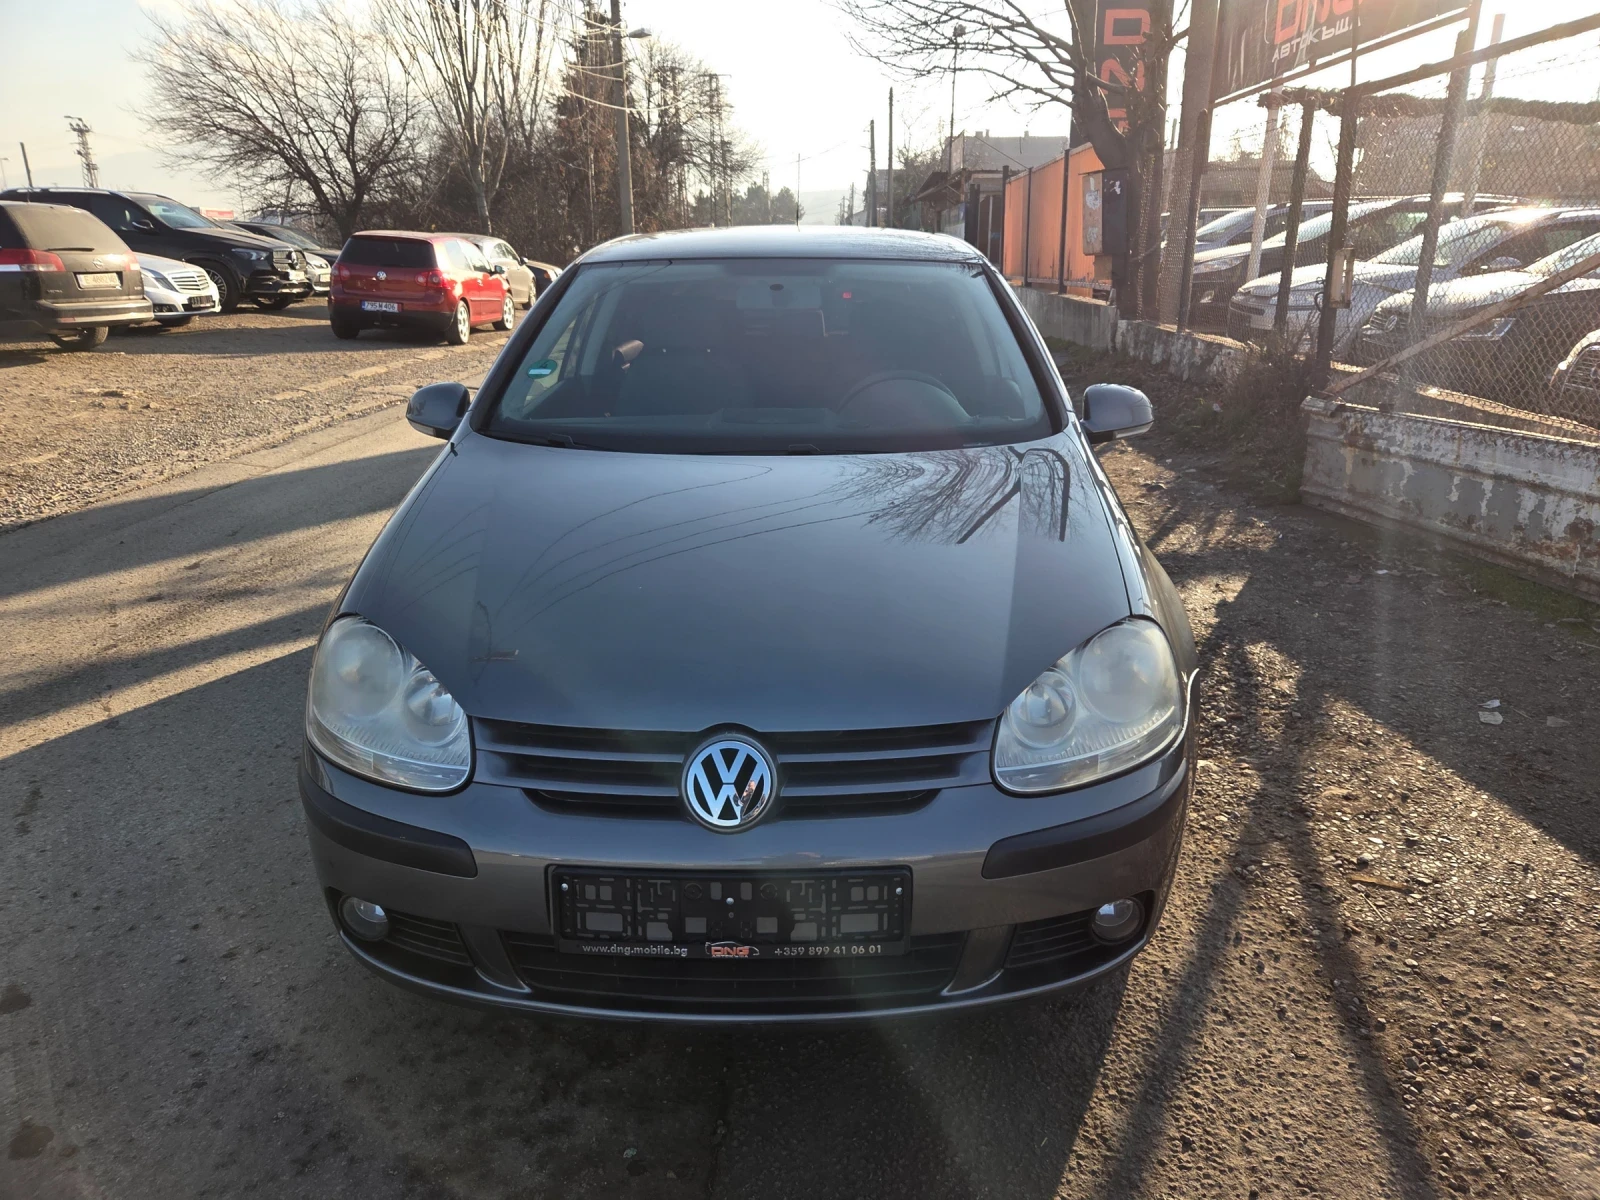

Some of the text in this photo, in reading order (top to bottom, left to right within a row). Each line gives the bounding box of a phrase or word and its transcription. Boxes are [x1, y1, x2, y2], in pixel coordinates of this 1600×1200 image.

[582, 944, 688, 957] www.dng.mobile.bg
[711, 946, 750, 955] DNG
[774, 944, 882, 956] +359 899 41 06 01
